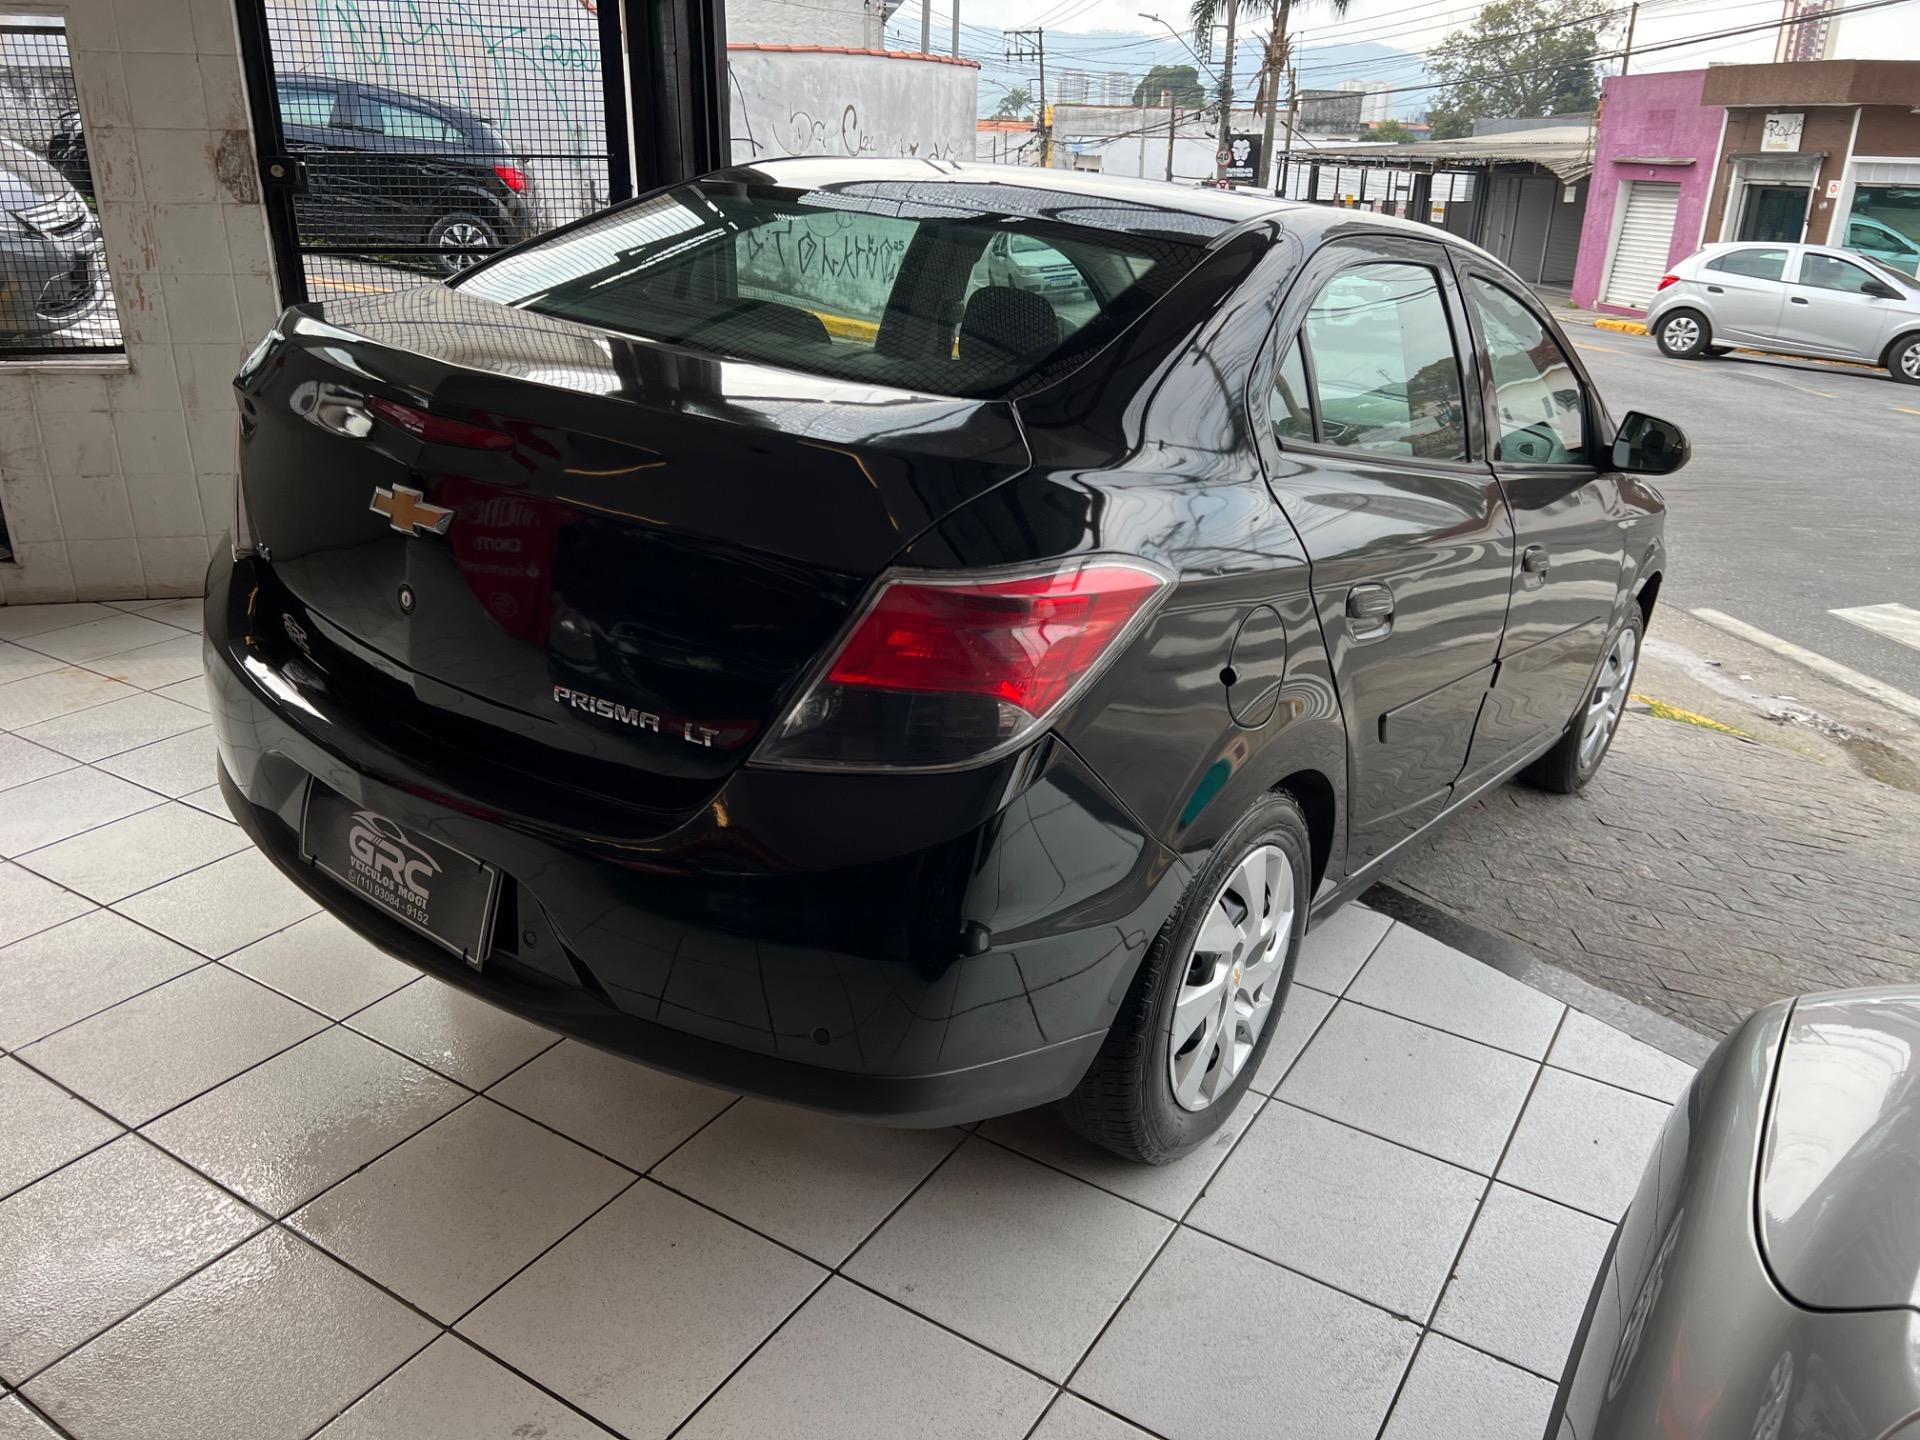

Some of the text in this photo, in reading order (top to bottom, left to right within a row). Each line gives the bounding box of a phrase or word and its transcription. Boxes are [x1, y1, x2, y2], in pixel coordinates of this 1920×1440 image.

[1218, 152, 1229, 161] 40
[553, 685, 720, 747] PRISMA LT
[349, 825, 434, 901] GRC
[350, 855, 429, 910] VEICULOS MOGI
[356, 873, 373, 893] (11)
